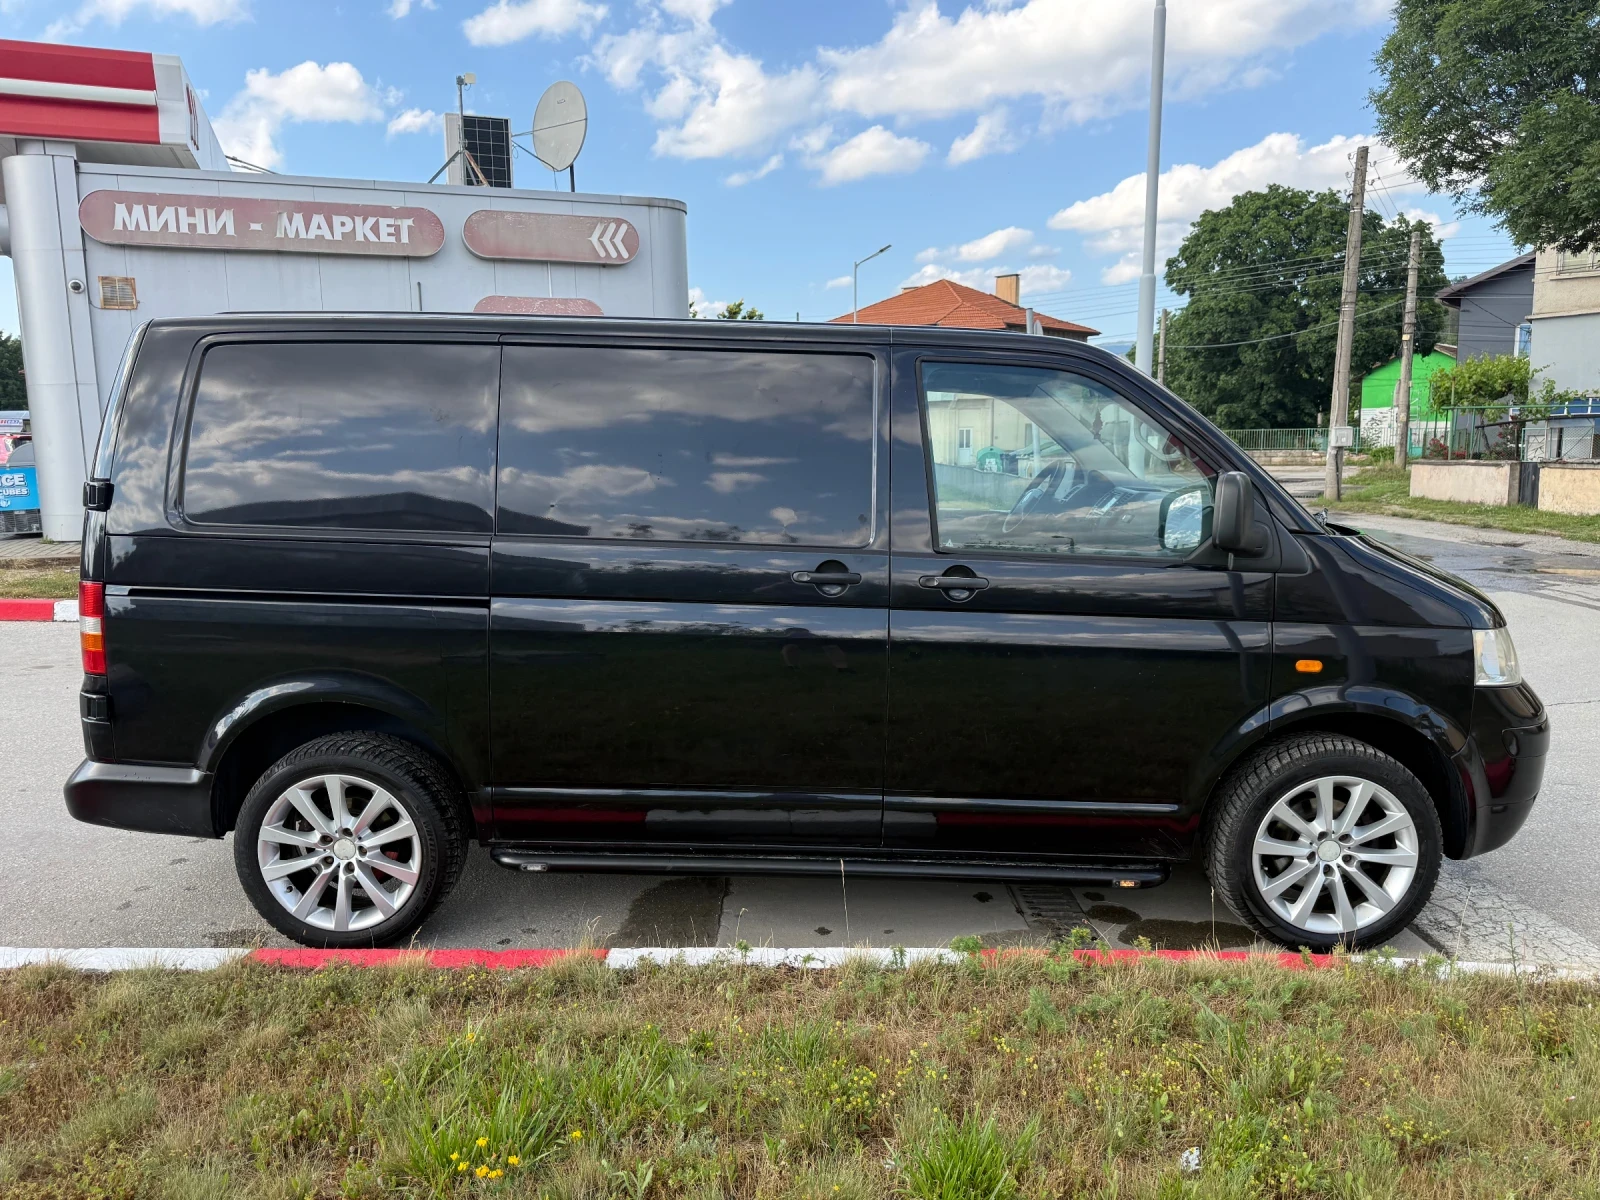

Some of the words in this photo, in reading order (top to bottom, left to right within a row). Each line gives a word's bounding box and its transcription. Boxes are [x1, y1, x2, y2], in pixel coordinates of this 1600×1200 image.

[112, 201, 237, 237] МИНИ
[275, 211, 415, 244] МАРКЕТ
[0, 473, 26, 486] CE
